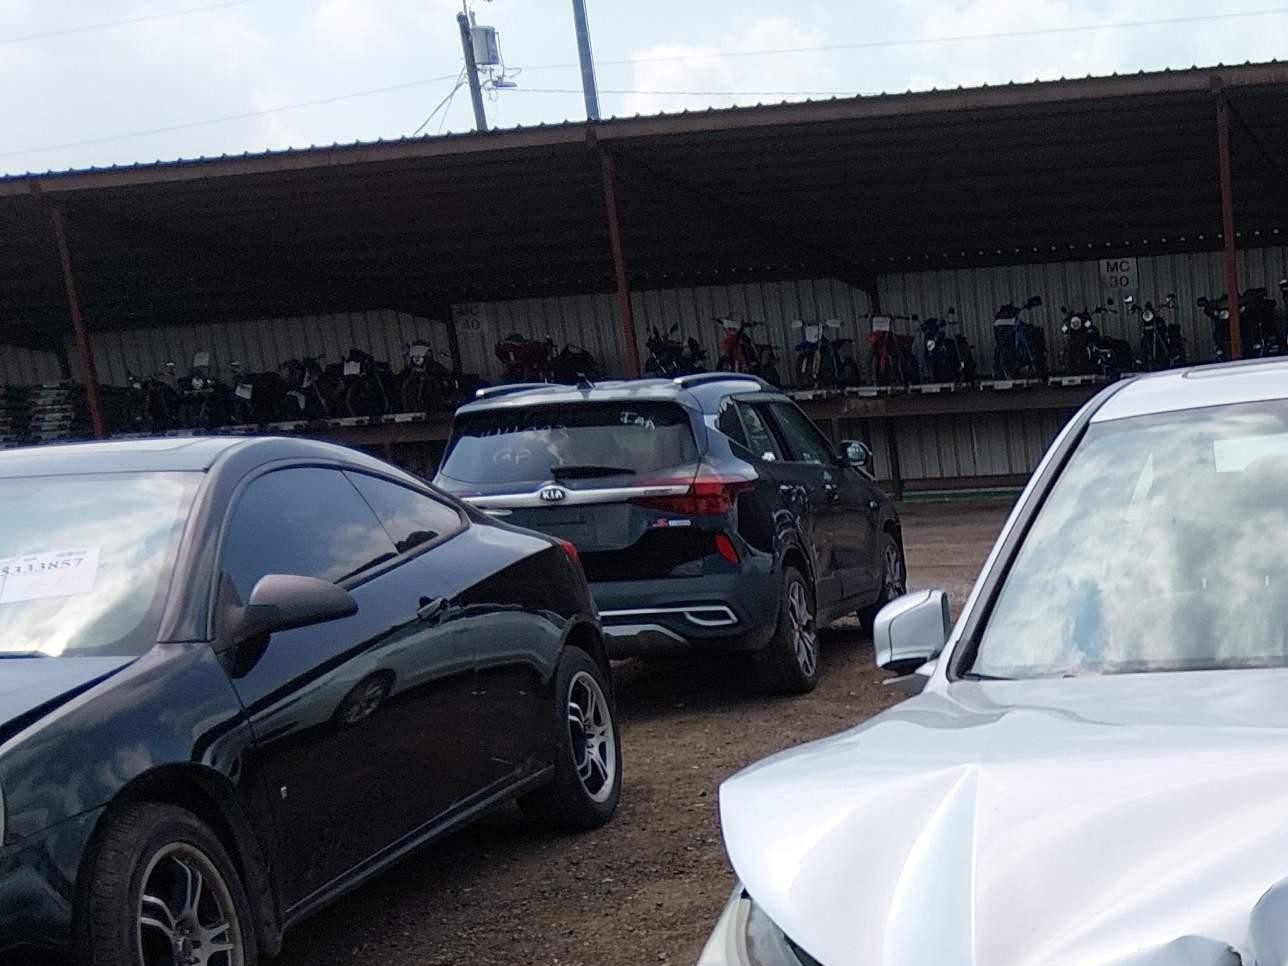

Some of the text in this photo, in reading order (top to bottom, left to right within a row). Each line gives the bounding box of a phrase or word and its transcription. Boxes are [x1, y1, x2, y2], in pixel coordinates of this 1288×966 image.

[1106, 260, 1130, 273] MC
[1110, 275, 1129, 288] 30
[541, 490, 564, 501] KIA
